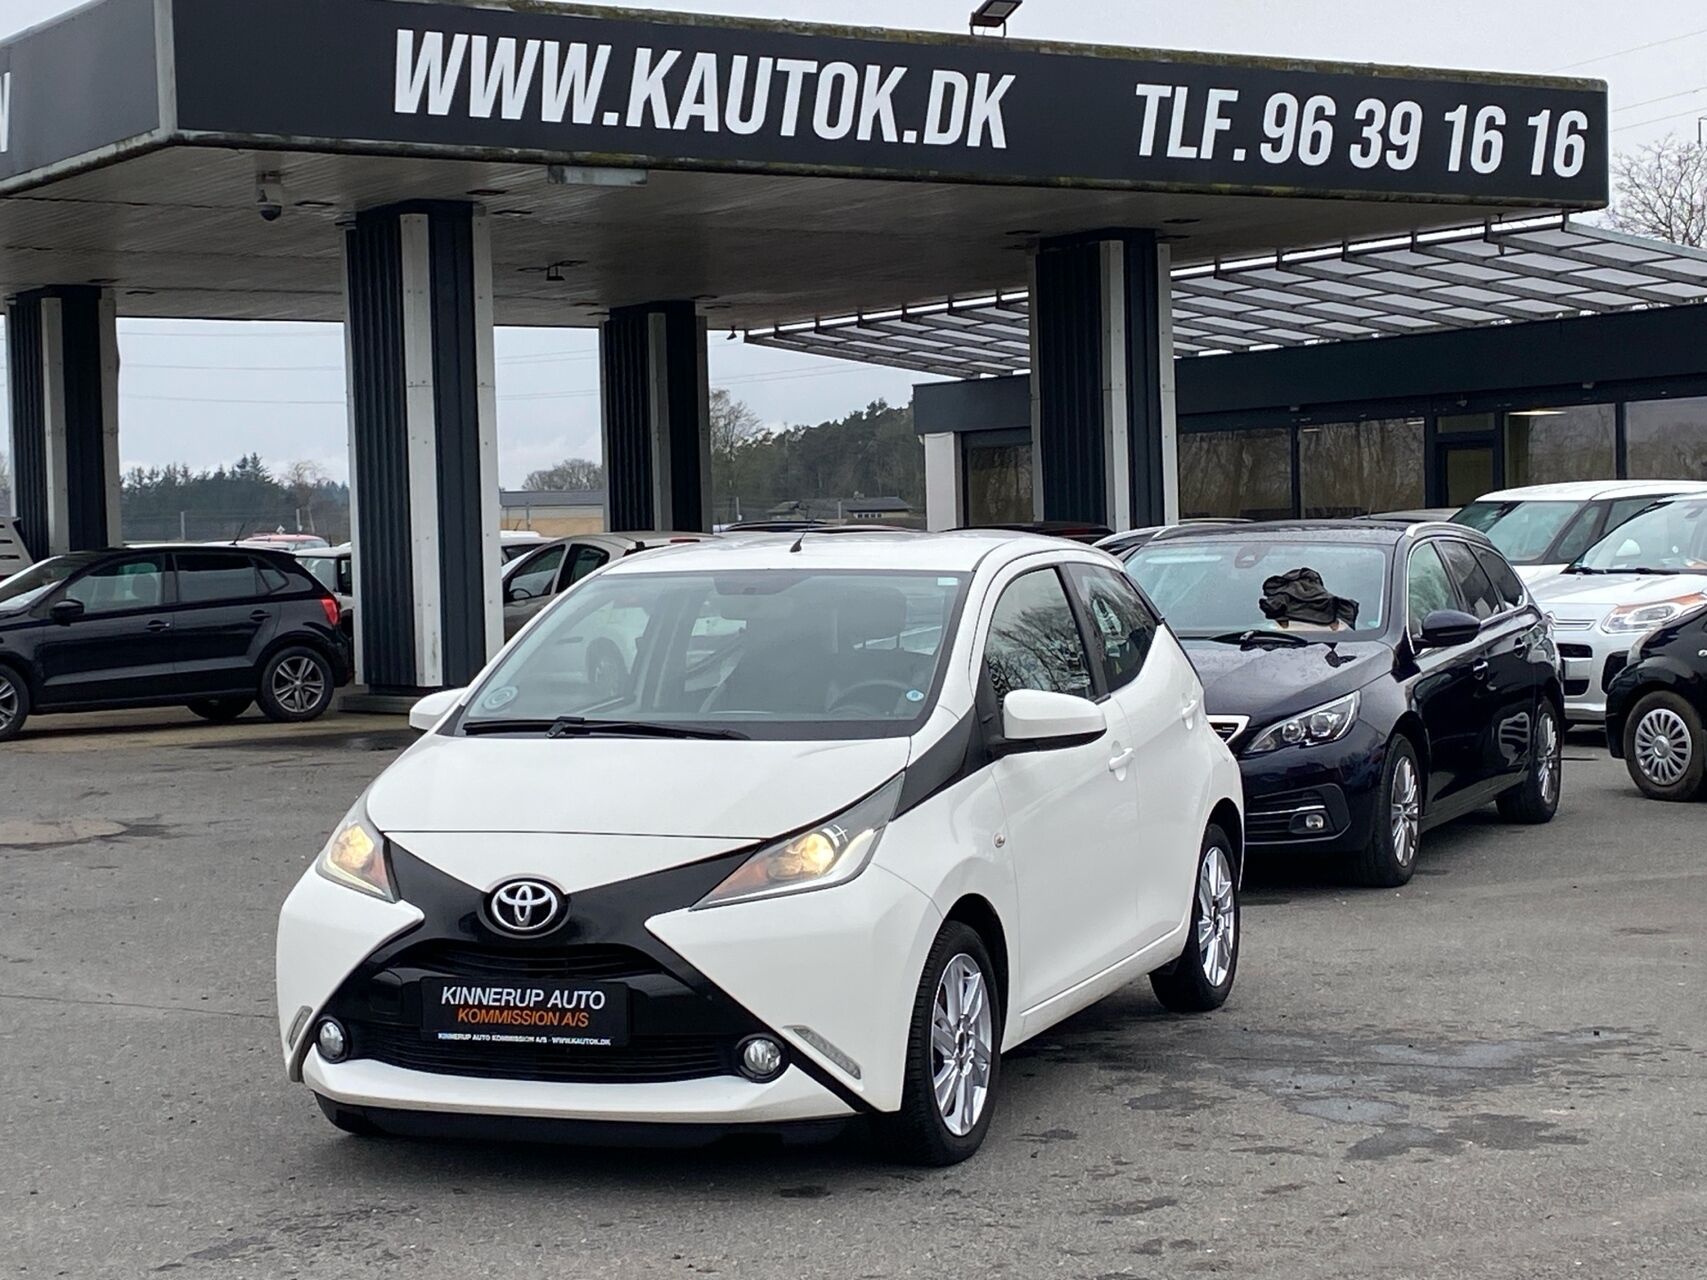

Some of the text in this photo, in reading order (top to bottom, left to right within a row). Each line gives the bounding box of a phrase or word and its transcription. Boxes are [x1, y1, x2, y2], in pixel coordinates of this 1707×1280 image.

[394, 28, 1017, 150] WWW.KAUTOK.DK
[1135, 83, 1589, 178] TLF. 96 39 16 16
[441, 986, 606, 1010] KINNERUP AUTO
[457, 1008, 590, 1028] KOMMISSION A/S
[438, 1033, 472, 1041] KINNERUP
[472, 1033, 490, 1042] AUTO
[491, 1034, 535, 1043] KOMMISSION
